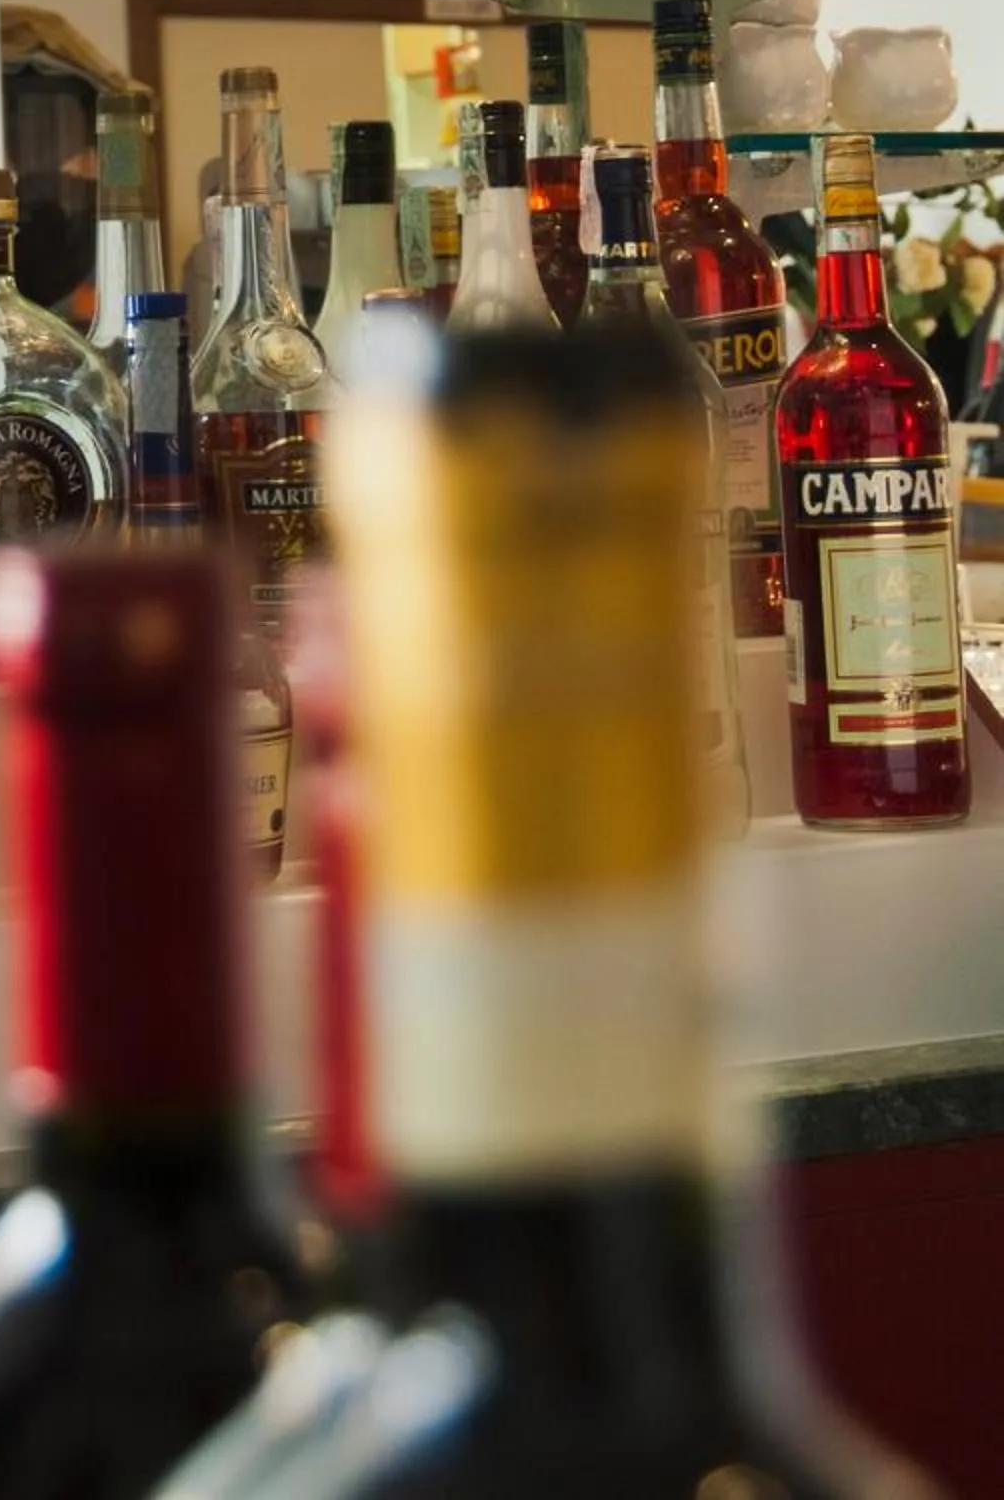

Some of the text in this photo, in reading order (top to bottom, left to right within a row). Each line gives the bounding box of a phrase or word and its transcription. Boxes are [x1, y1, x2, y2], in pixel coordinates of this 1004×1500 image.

[696, 326, 785, 374] PEROL
[8, 421, 83, 495] ROMAGNA
[802, 465, 953, 516] CAMPAR
